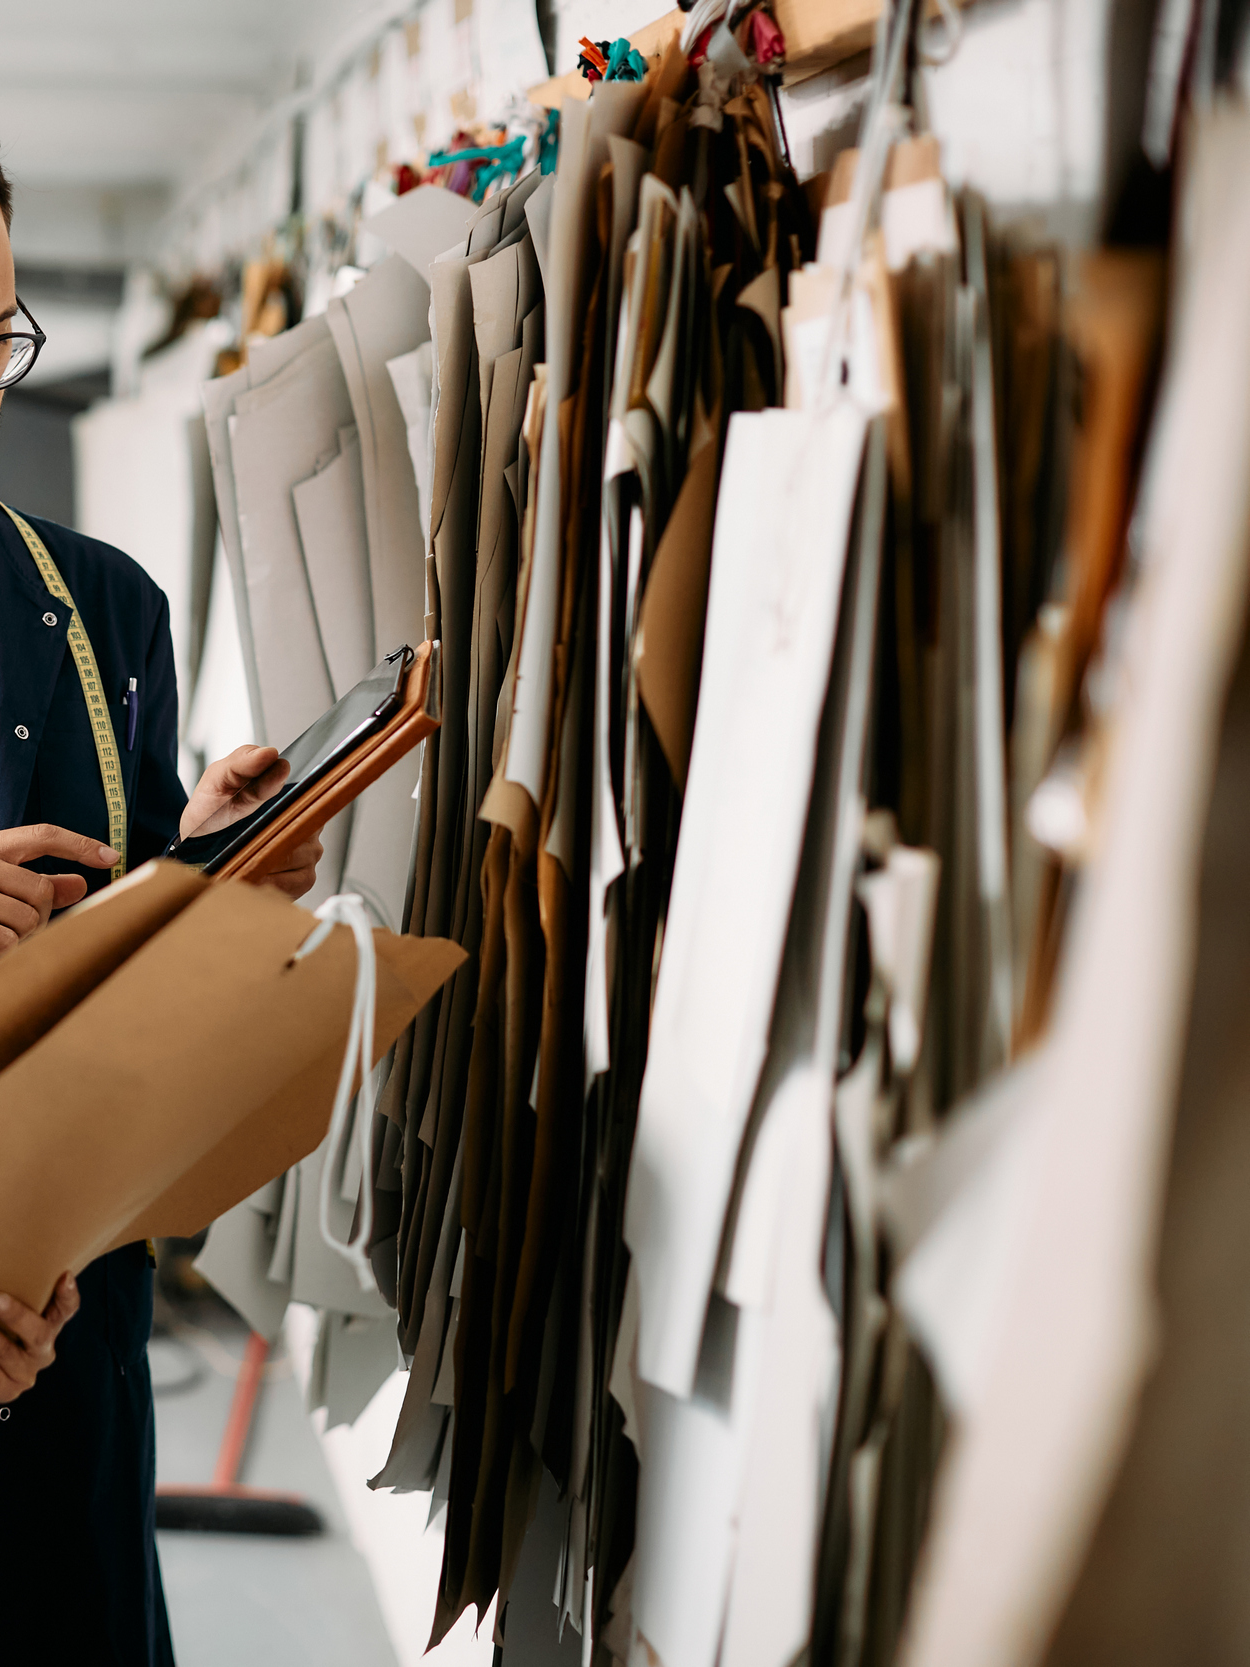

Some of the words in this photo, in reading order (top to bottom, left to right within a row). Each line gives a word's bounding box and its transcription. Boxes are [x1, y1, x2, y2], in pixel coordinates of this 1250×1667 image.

[76, 643, 86, 652] 104
[79, 656, 90, 664] 105
[83, 669, 93, 677] 106
[86, 681, 96, 690] 107
[90, 694, 100, 703] 108
[93, 707, 103, 717] 109
[96, 721, 106, 730] 110
[99, 734, 108, 743] 111
[102, 747, 112, 756] 112
[105, 760, 114, 770] 113
[107, 774, 116, 783] 114
[109, 787, 118, 796] 115
[112, 800, 121, 810] 116
[113, 814, 122, 823] 117
